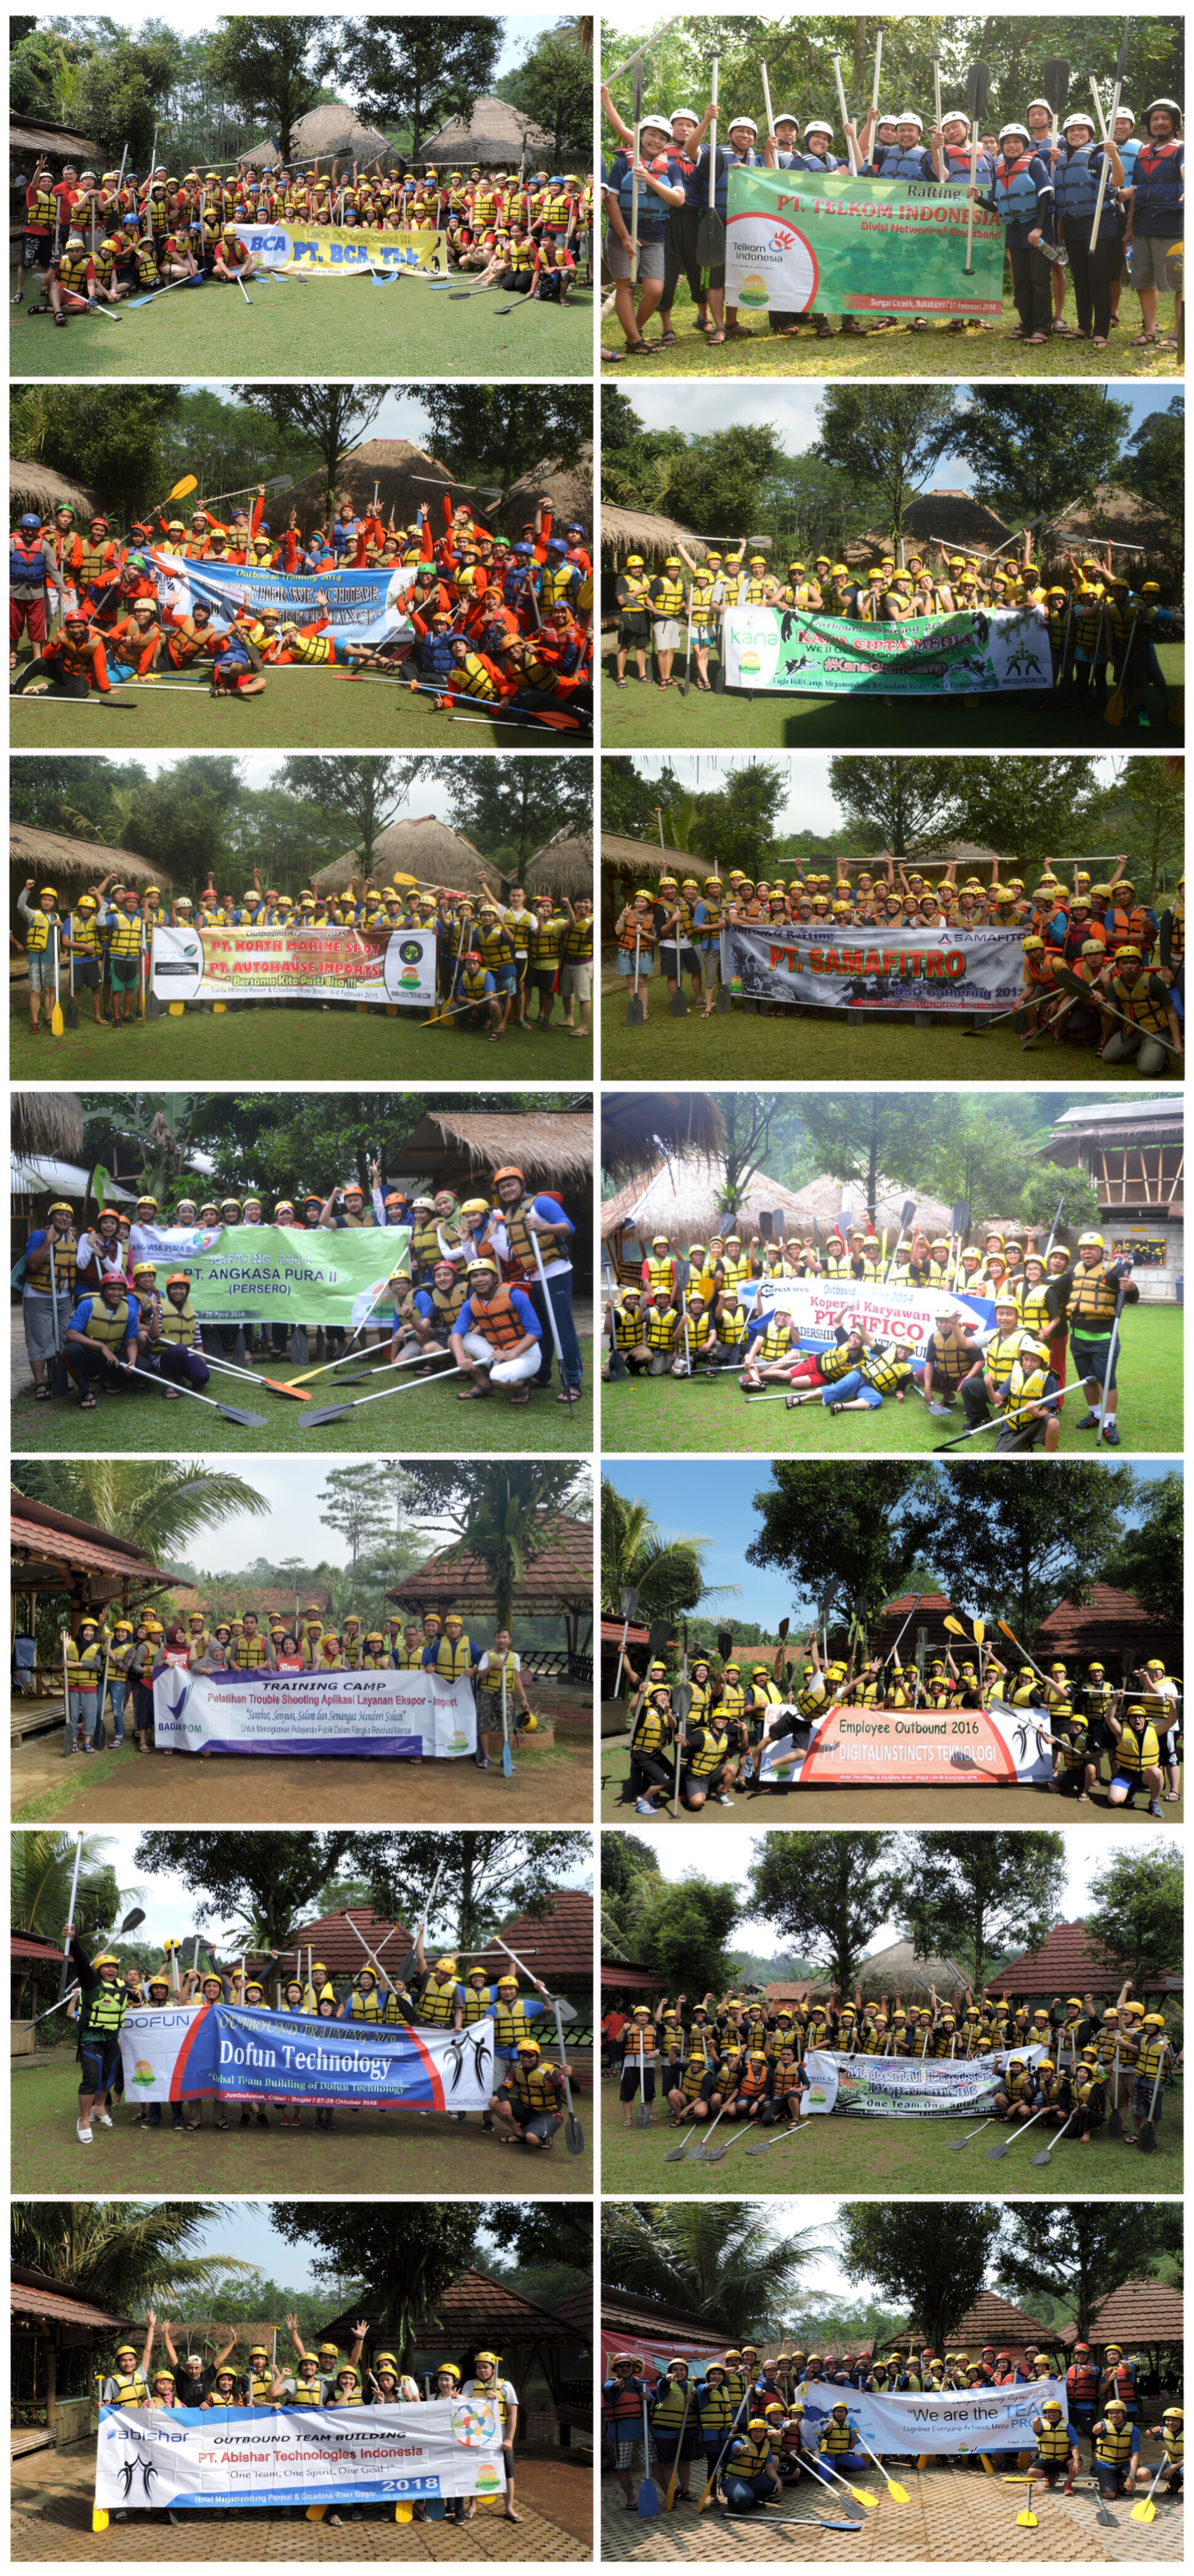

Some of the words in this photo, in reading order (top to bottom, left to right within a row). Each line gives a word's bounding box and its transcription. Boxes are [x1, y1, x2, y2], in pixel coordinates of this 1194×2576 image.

[908, 185, 961, 201] Rafting
[777, 194, 805, 212] PT.
[812, 198, 893, 218] TELKOM
[898, 205, 1002, 226] INDONESIA
[861, 221, 888, 232] Divisi
[891, 224, 933, 235] Network
[936, 226, 947, 235] of
[250, 236, 286, 251] BCA
[732, 242, 766, 252] Telkom
[293, 242, 323, 262] PT.
[380, 247, 419, 267] Tbk
[735, 252, 783, 262] Indonesia
[236, 569, 279, 580] Outbound
[289, 587, 314, 604] WE
[730, 626, 778, 646] kana
[852, 638, 910, 652] CIPTA
[913, 633, 974, 651] MEDIA
[786, 930, 834, 941] Rafting
[954, 933, 1031, 943] SAMAFITR
[211, 940, 233, 952] PT.
[235, 940, 283, 952] NORTH
[286, 940, 341, 952] MARINE
[345, 943, 379, 955] SPOT
[209, 962, 230, 974] PT.
[232, 961, 315, 974] AUTOHAUSE
[318, 962, 380, 976] IMPORTS
[768, 945, 804, 973] PT.
[808, 947, 967, 979] SAMAFITRO
[232, 975, 276, 987] Bersama
[300, 975, 324, 986] Pasti
[325, 976, 345, 988] Bisa
[927, 986, 991, 999] Gathering
[208, 1268, 281, 1280] ANGKASA
[285, 1269, 325, 1282] PURA
[329, 1271, 337, 1283] II
[229, 1284, 291, 1296] (PERSERO)
[810, 1296, 860, 1311] Koperi
[864, 1301, 930, 1321] Karyawan
[848, 1313, 924, 1341] TIFICO
[262, 1682, 338, 1690] TRAINING
[343, 1682, 386, 1690] CAMP
[248, 1694, 279, 1704] Trouble
[281, 1694, 319, 1706] Shooting
[321, 1694, 355, 1706] Aplikasi
[357, 1695, 393, 1707] Layanan
[182, 1724, 202, 1733] POM
[839, 1719, 890, 1737] Employee
[895, 1721, 947, 1735] Outbound
[952, 1721, 979, 1734] 2016
[936, 1745, 996, 1762] TEKNOLOGI
[123, 2014, 189, 2029] DOFUN
[220, 2014, 298, 2035] OUTBOUND
[300, 2024, 370, 2045] TRAINING
[220, 2040, 276, 2068] Dofun
[282, 2045, 393, 2080] Technology
[846, 2065, 922, 2082] Material
[237, 2076, 262, 2087] Team
[265, 2079, 306, 2090] Building
[308, 2081, 318, 2090] of
[320, 2082, 349, 2091] Dofun
[869, 2080, 978, 2099] Department
[908, 2409, 939, 2422] "We
[944, 2410, 968, 2421] are
[973, 2406, 998, 2421] the
[1003, 2400, 1045, 2418] TEA
[118, 2429, 189, 2442] abishar
[214, 2436, 291, 2444] OUTBOUND
[335, 2432, 406, 2441] BUILDING
[198, 2452, 217, 2463] PT.
[221, 2451, 271, 2463] Abishar
[273, 2449, 357, 2462] Technologies
[360, 2446, 423, 2458] Indonesia
[382, 2478, 438, 2492] 2018
